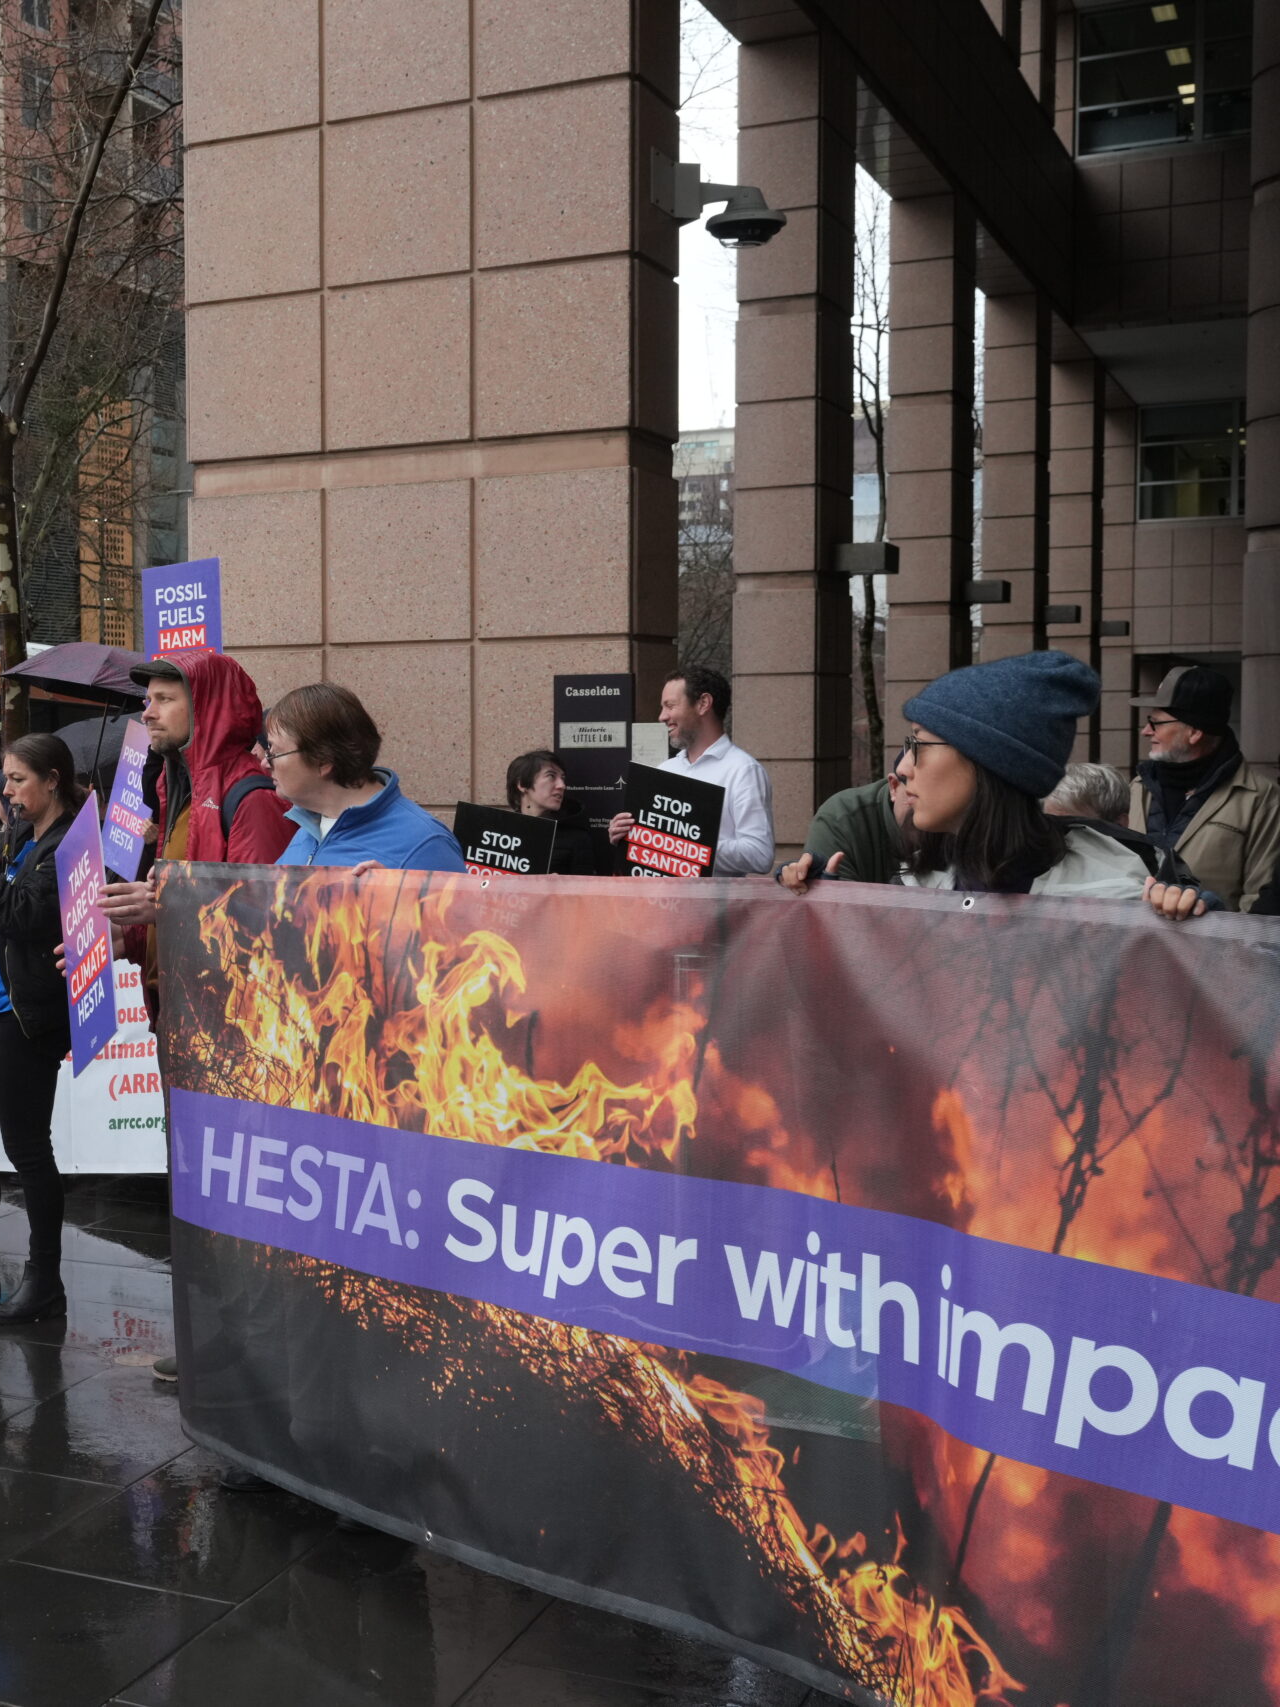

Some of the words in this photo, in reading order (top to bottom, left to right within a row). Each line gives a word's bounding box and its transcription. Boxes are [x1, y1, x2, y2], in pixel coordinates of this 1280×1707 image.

[155, 582, 207, 606] FOSSIL
[159, 605, 205, 628] FUELS
[160, 628, 205, 650] HARM
[565, 686, 621, 697] Casselden
[123, 745, 147, 769] PROT
[111, 804, 142, 836] FUTURE
[652, 794, 692, 817] STOP
[109, 825, 134, 853] HESTA
[638, 809, 701, 840] LETTING
[481, 831, 522, 851] STOP
[628, 826, 709, 863] WOODSIDE
[68, 849, 91, 897] TAKE
[466, 845, 530, 872] LETTING
[628, 845, 638, 861] &
[640, 849, 700, 877] SANTOS
[66, 890, 88, 936] CARE
[87, 871, 100, 906] OF
[76, 916, 95, 957] OUR
[71, 935, 107, 998] CLIMATE
[77, 977, 105, 1027] HESTA
[108, 1072, 162, 1101] (ARR
[201, 1126, 422, 1250] HESTA:
[443, 1178, 698, 1307] Super
[723, 1231, 920, 1366] with
[937, 1263, 1280, 1472] impa
